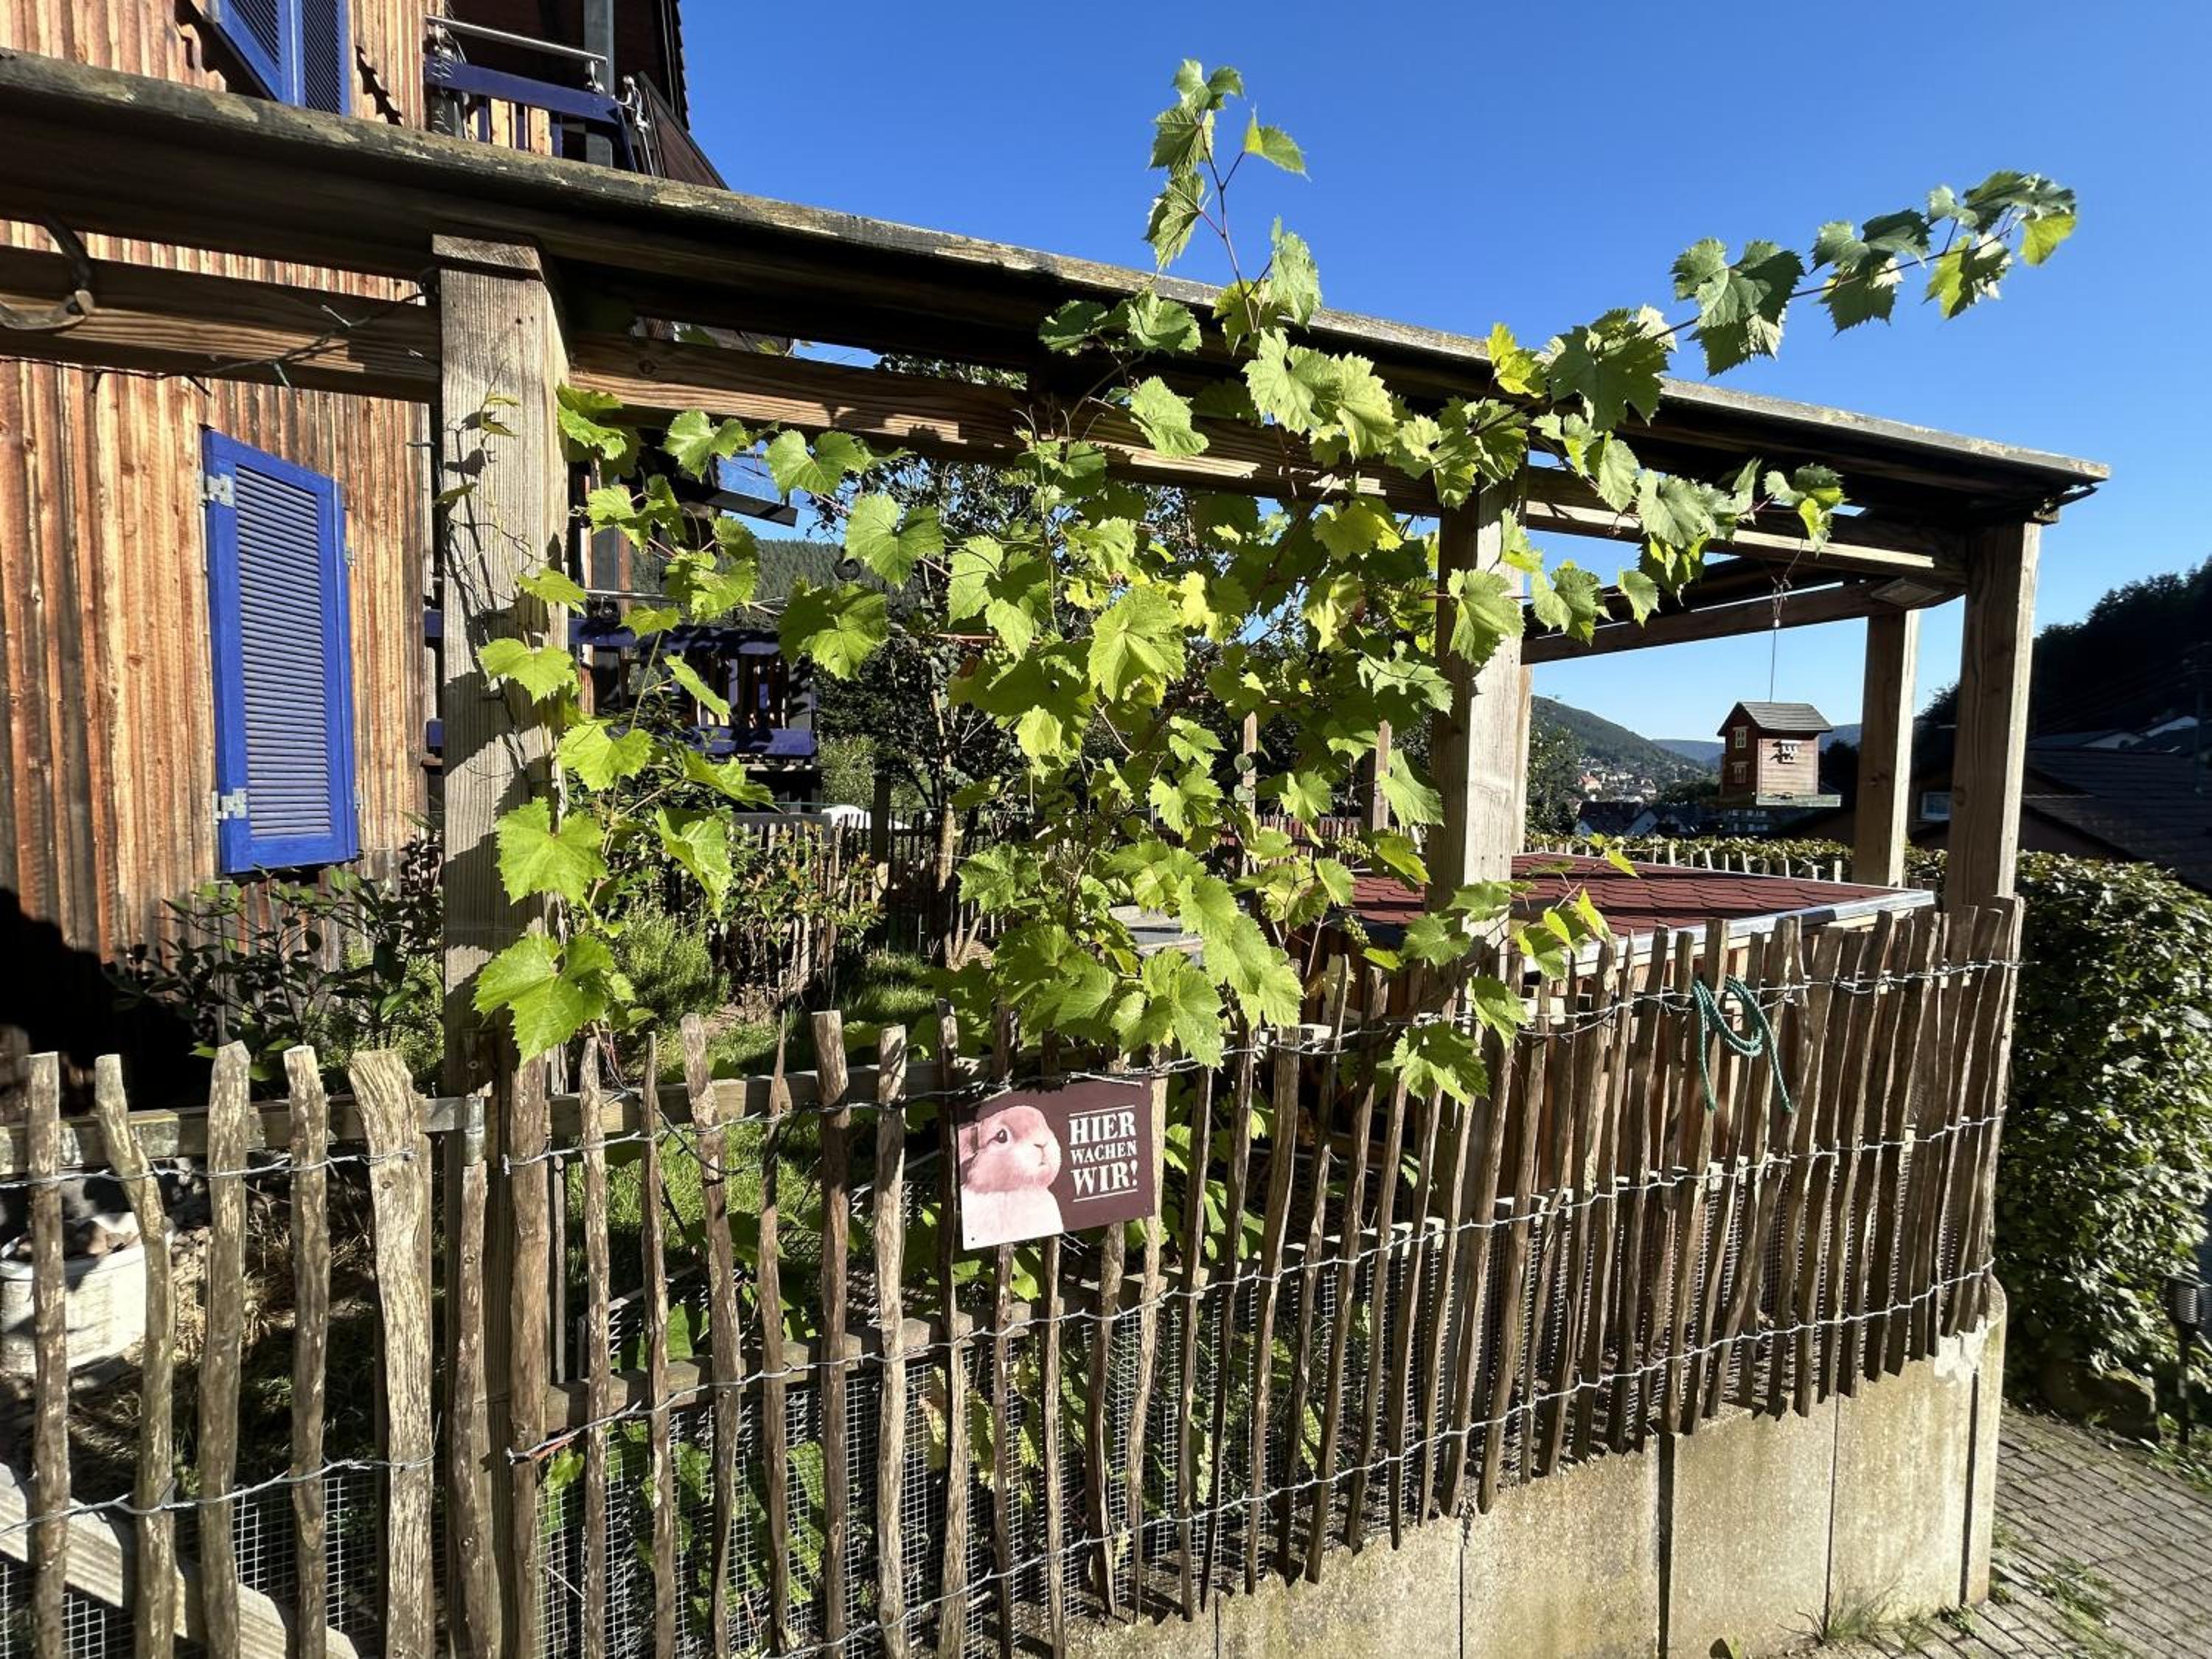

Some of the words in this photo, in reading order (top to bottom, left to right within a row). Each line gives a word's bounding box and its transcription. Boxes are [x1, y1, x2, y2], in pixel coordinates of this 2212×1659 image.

[1069, 1111, 1136, 1145] HIER
[1071, 1140, 1138, 1164] WACHEN
[1071, 1160, 1138, 1196] WIR!
